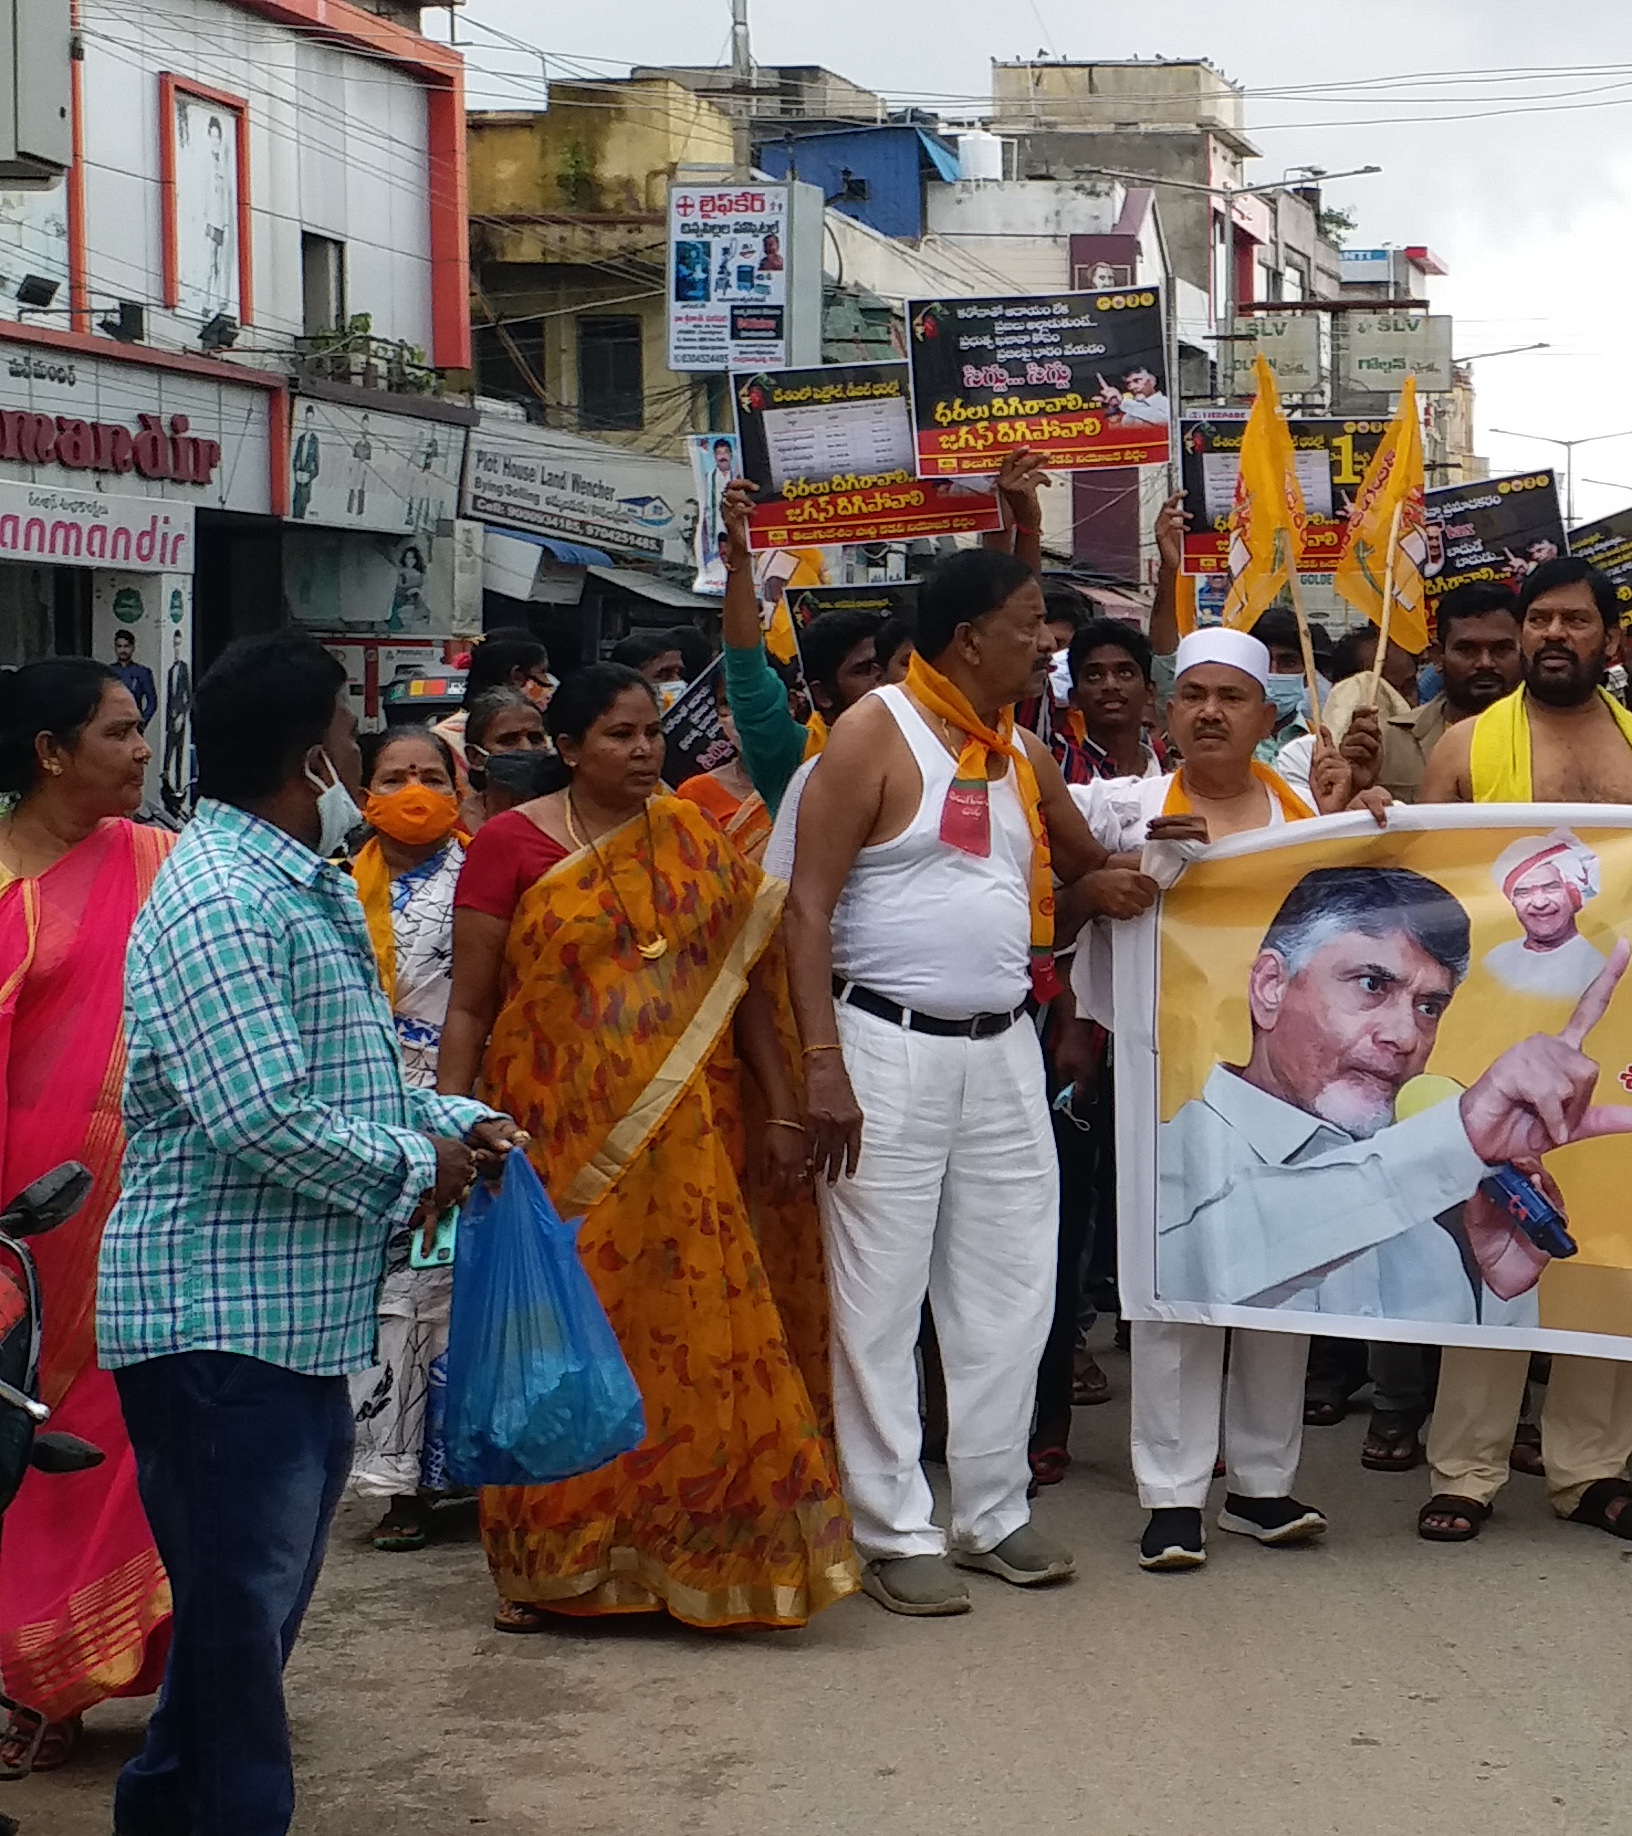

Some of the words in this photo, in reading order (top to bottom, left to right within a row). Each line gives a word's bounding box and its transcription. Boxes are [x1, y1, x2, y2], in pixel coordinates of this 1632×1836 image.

[1377, 318, 1421, 333] SLV
[935, 399, 989, 426] ధరలు
[939, 421, 994, 450] జగన్
[997, 417, 1101, 442] దిగిపోవాలి
[475, 450, 498, 475] Plot
[502, 457, 536, 483] House
[541, 465, 567, 491] Land
[1333, 435, 1361, 484] 1
[782, 476, 830, 500] ధరలు
[832, 469, 918, 492] దిగిరావాలి..
[786, 497, 834, 522] జగన్
[837, 490, 924, 515] దిగిపోవాలి
[0, 514, 187, 566] anmandir
[1301, 574, 1333, 585] GOLDE
